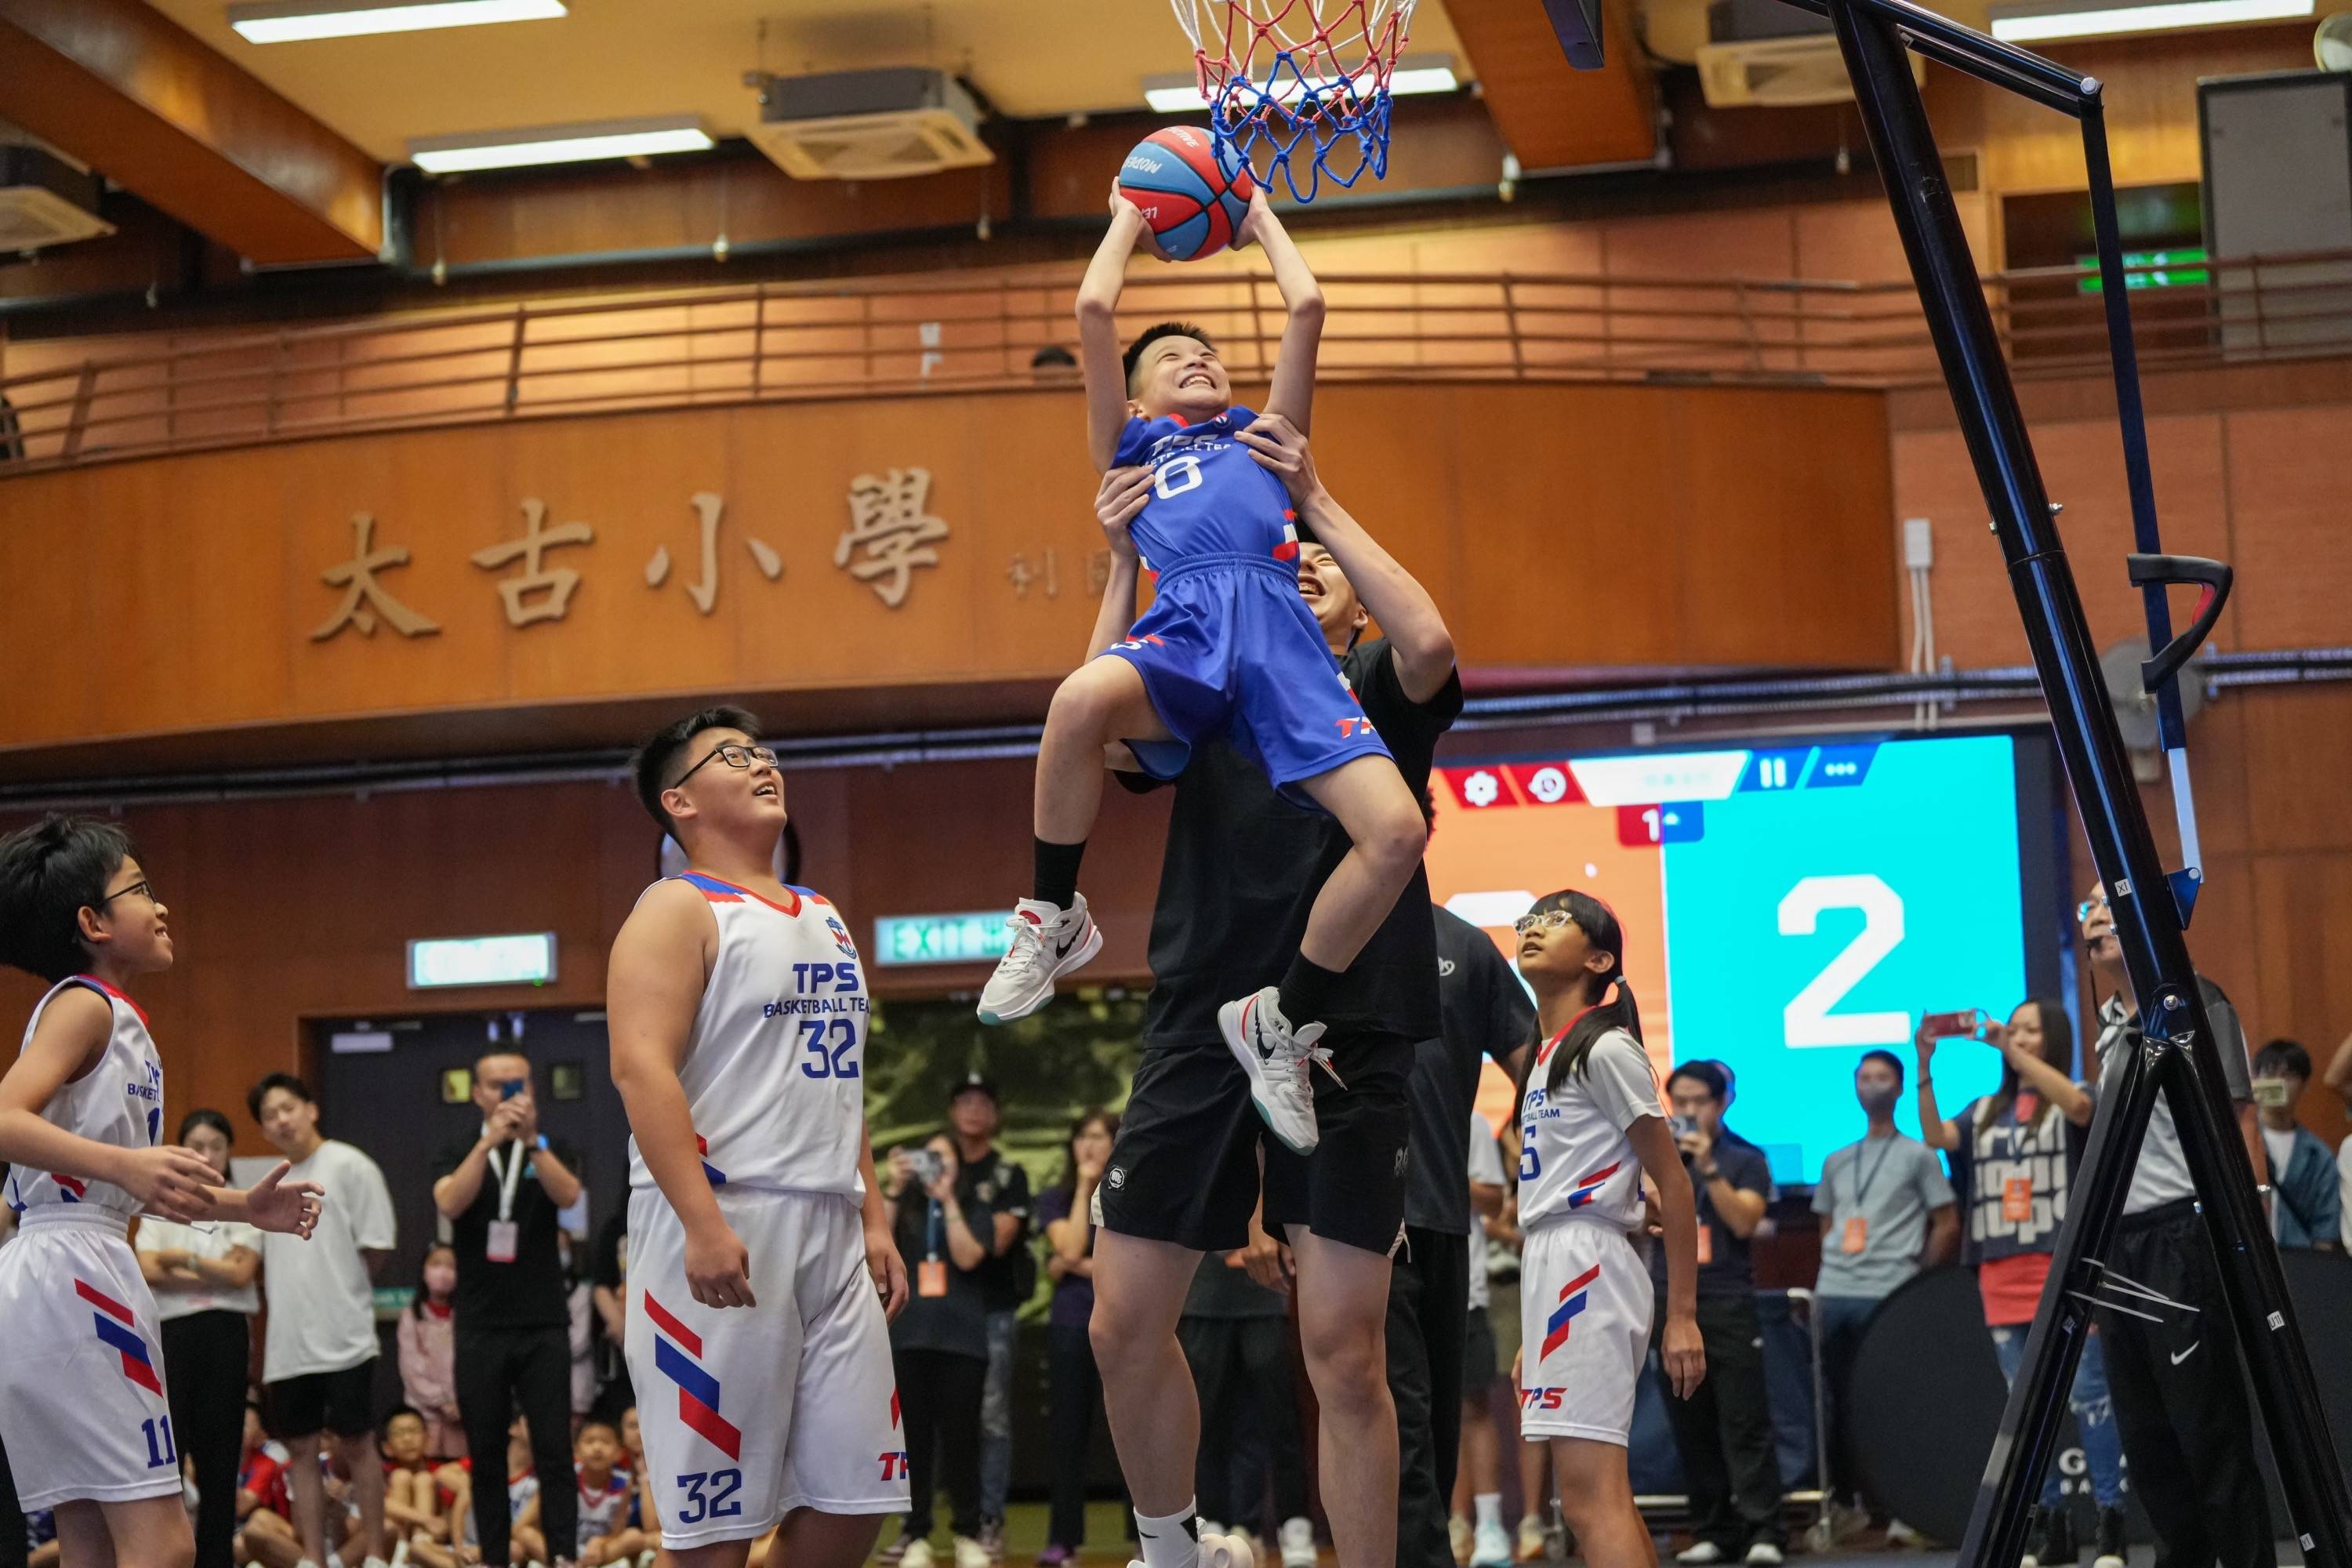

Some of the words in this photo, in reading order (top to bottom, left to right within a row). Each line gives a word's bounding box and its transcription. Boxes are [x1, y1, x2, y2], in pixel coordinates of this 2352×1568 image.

[310, 468, 949, 641] 太古小學
[1334, 716, 1376, 739] TP
[894, 919, 967, 960] EXIT
[982, 914, 1007, 956] 出
[792, 963, 859, 994] TPS
[1777, 873, 1911, 1049] 2
[764, 998, 847, 1018] BASKETBALL
[849, 996, 869, 1014] TEA
[798, 1018, 859, 1079] 32
[1523, 1088, 1548, 1113] TPS
[1538, 1108, 1560, 1119] TEAM
[1519, 1124, 1541, 1181] 5
[1520, 1387, 1567, 1410] TPS
[141, 1414, 176, 1469] 11
[677, 1468, 742, 1524] 32
